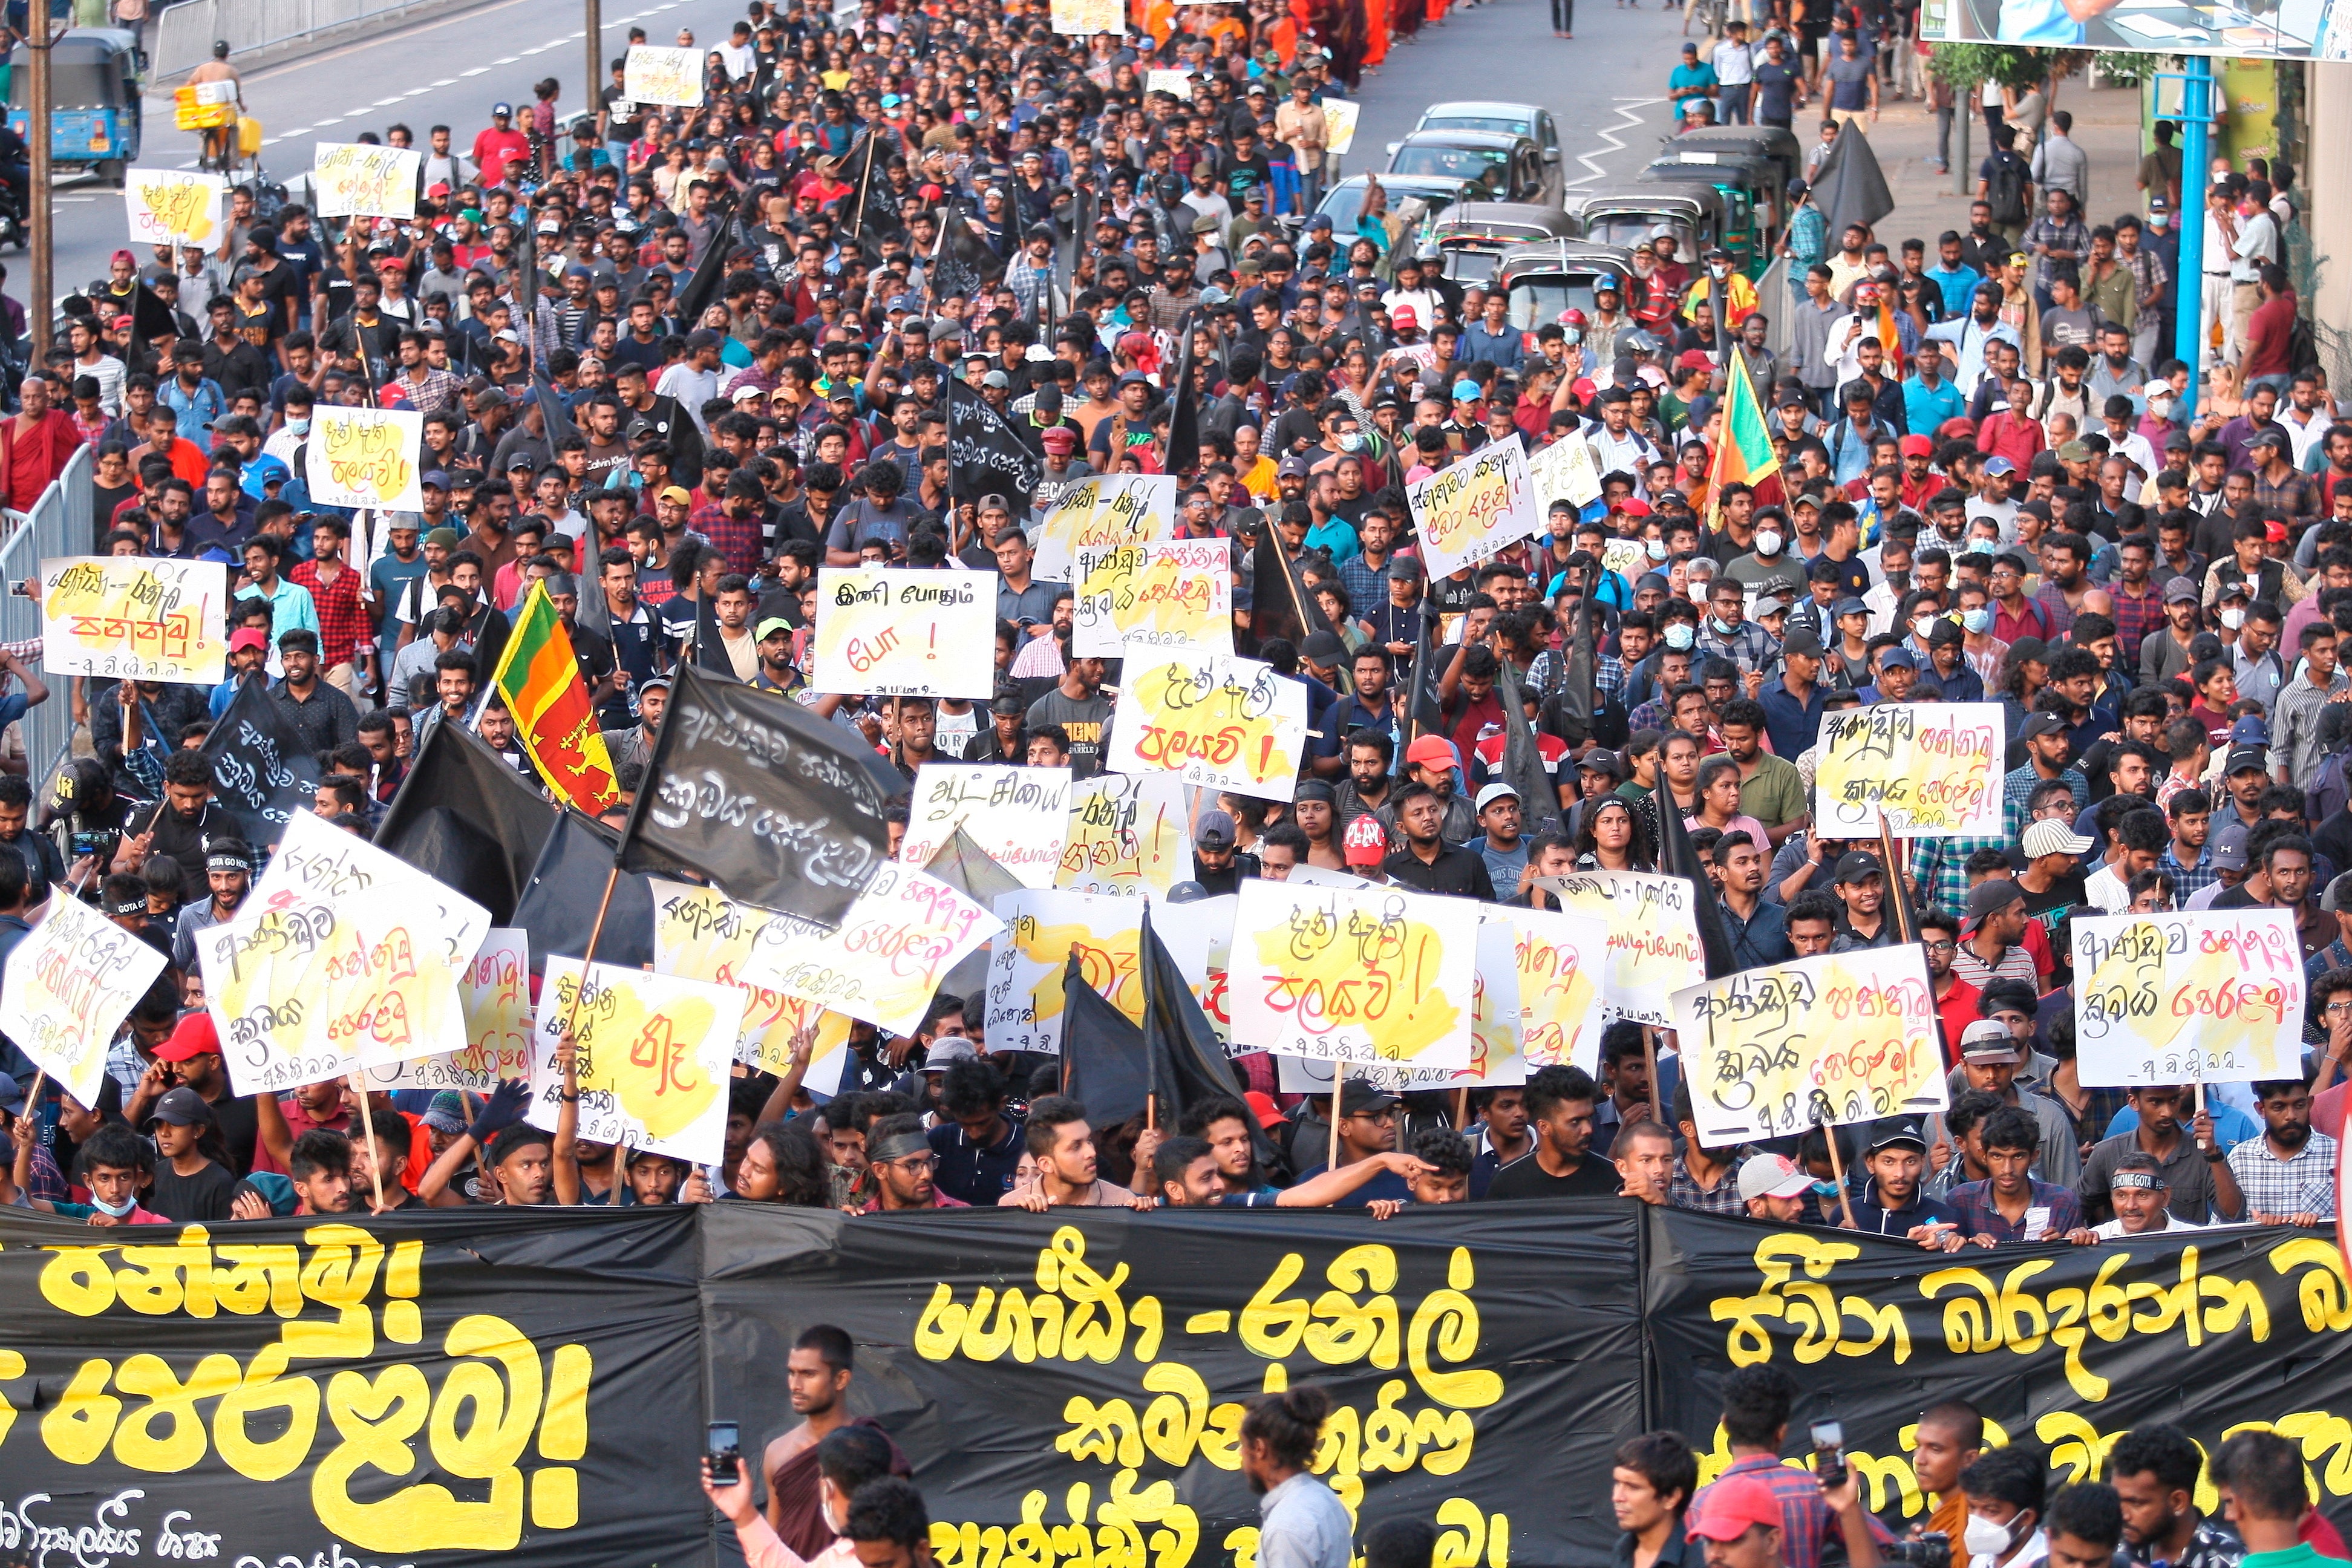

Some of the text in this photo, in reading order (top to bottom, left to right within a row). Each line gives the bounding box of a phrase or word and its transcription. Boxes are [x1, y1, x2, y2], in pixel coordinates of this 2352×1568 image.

[642, 579, 674, 594] LIFE IS
[835, 581, 975, 607] இனி போதும்
[846, 626, 900, 673] போ
[209, 858, 224, 867] GOTA
[224, 857, 235, 866] GO
[118, 902, 139, 913] GOTA
[2117, 1174, 2135, 1186] HOME
[2134, 1174, 2151, 1188] GOTA
[39, 1224, 424, 1358] පන්නමු!
[1237, 1244, 1505, 1409] රනිල්
[41, 1315, 593, 1553] පෙරළමු!
